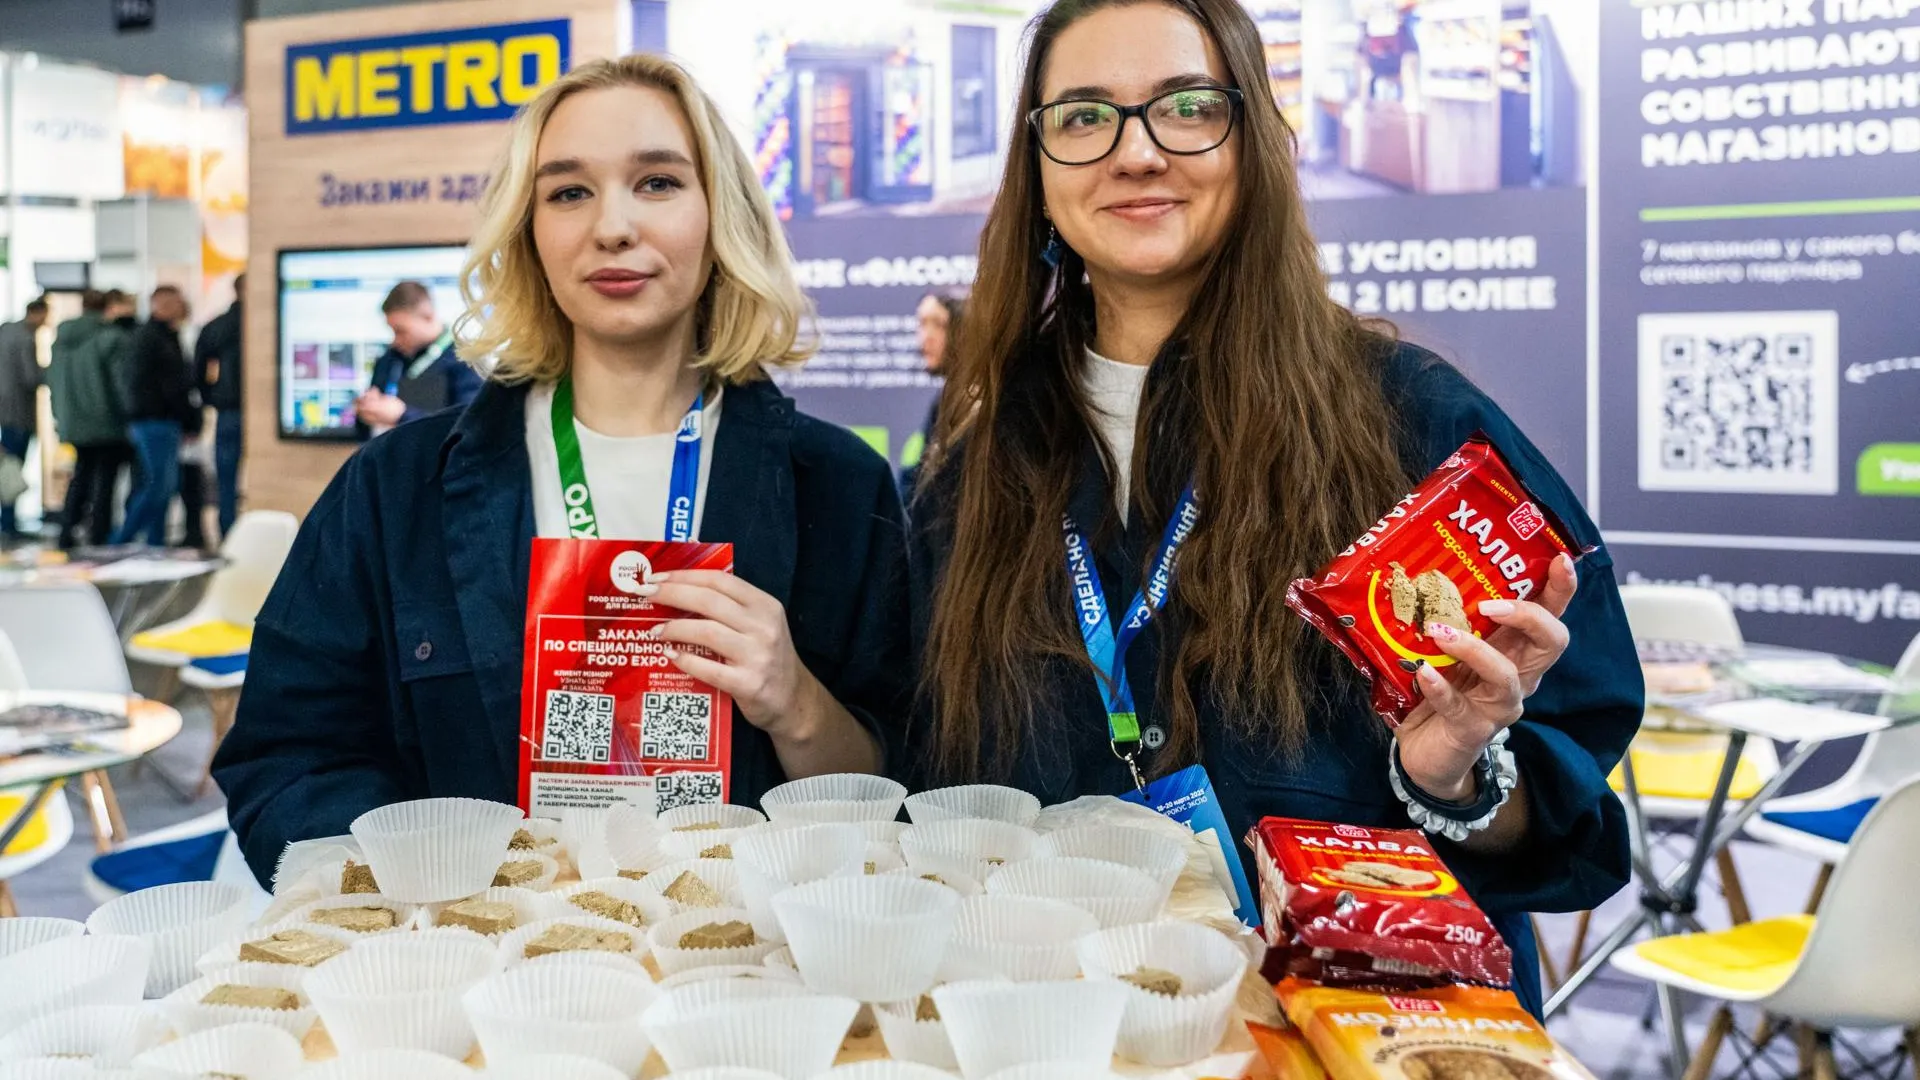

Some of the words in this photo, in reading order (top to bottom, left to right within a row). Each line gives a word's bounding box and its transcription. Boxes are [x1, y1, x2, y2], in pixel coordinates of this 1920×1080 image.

[1641, 0, 1815, 40] НАШИХ
[293, 34, 560, 121] METRO
[320, 172, 430, 207] Закажи
[1348, 236, 1537, 274] УСЛОВИЯ
[1640, 238, 1659, 263] 7
[1784, 237, 1803, 262] у
[1355, 280, 1381, 312] 2
[1386, 280, 1416, 312] И
[1422, 276, 1557, 311] БОЛЕЕ
[1490, 479, 1519, 504] ORIENTAL
[1337, 492, 1421, 558] ХАЛВА
[1512, 515, 1530, 534] Life
[1517, 507, 1538, 529] Fine
[1448, 500, 1536, 601] ХАЛВА
[1545, 527, 1567, 549] SWEETS
[1065, 533, 1101, 625] СДЕЛАНО
[544, 640, 565, 651] ПО
[570, 640, 673, 656] СПЕЦИАЛЬНОЙ
[587, 655, 627, 667] FOOD
[631, 656, 669, 668] EXPO
[538, 785, 579, 793] ПОДПИШИСЬ
[1295, 835, 1430, 856] ХАЛВА
[1445, 924, 1484, 945] 250г
[1329, 1011, 1535, 1033] КОЗИНАК
